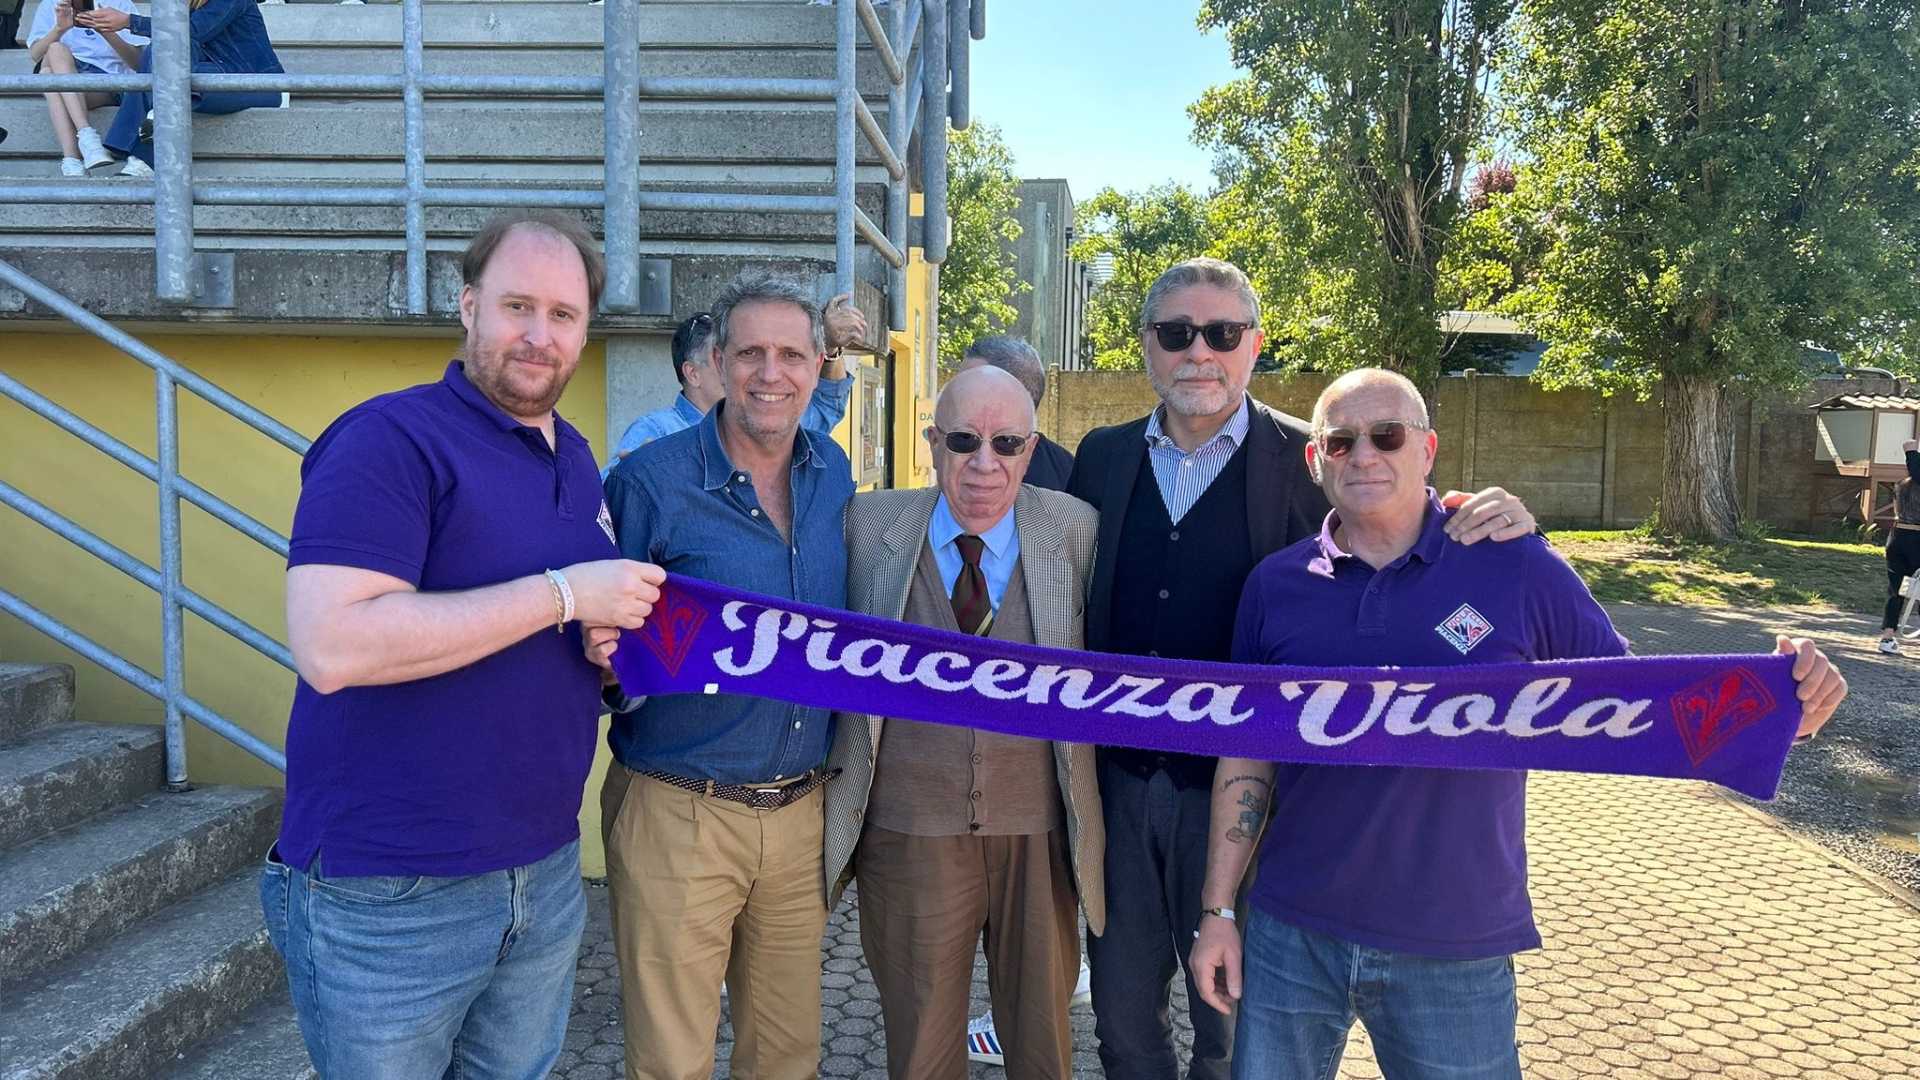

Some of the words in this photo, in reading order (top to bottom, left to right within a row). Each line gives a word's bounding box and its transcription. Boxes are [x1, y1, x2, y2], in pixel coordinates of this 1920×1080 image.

[1447, 609, 1471, 628] VIOLA
[1434, 626, 1468, 655] PIACENZA
[713, 601, 1254, 725] Piacenza
[1280, 677, 1653, 746] Viola
